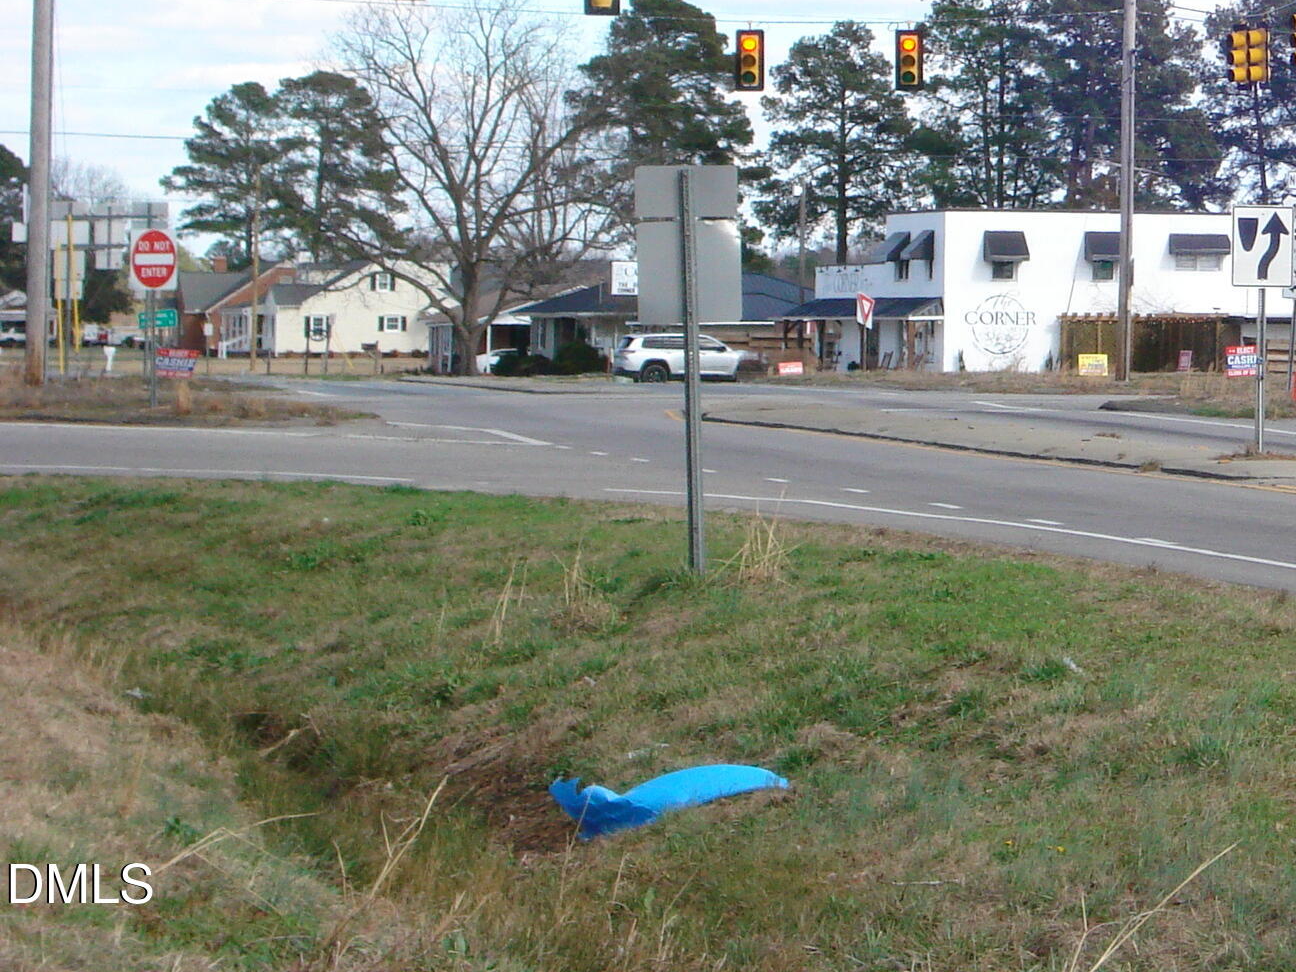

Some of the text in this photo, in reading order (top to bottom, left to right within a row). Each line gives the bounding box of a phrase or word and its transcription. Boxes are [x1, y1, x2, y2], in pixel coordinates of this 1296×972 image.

[138, 241, 170, 252] DO NOT
[141, 267, 167, 278] ENTER
[965, 311, 1037, 325] CORNER
[1236, 346, 1254, 354] ELECT
[1227, 354, 1257, 365] CASHI
